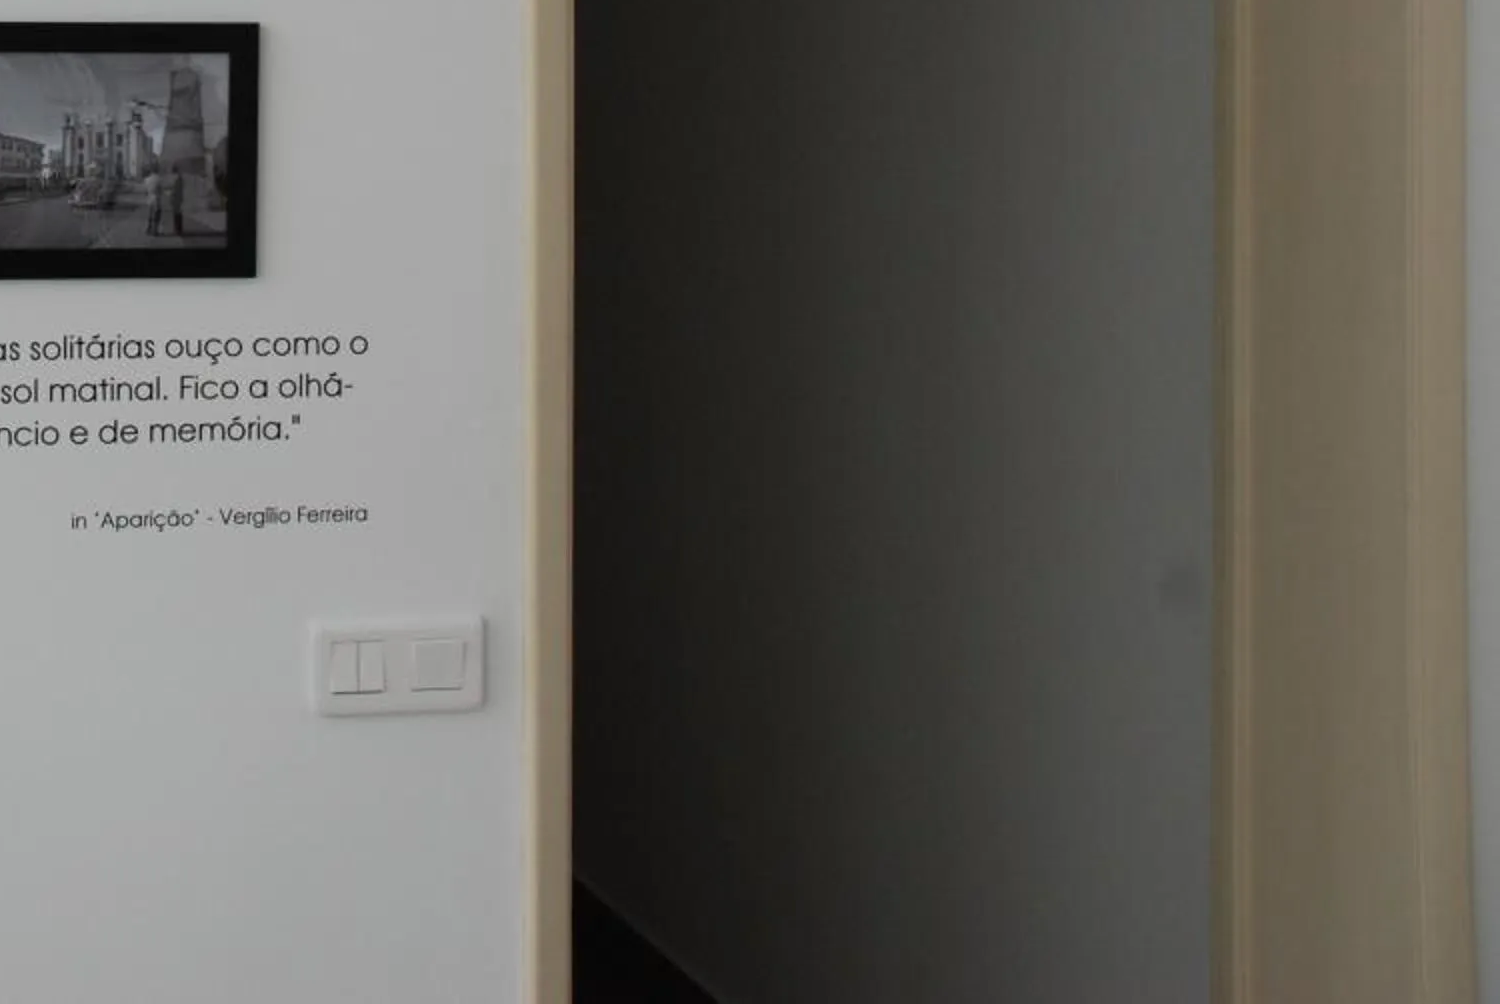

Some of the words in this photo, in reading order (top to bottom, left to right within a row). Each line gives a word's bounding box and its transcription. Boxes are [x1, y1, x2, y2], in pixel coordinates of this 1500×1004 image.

[29, 333, 156, 362] solitárias
[164, 336, 244, 367] ouço
[251, 335, 341, 358] como
[348, 334, 369, 356] o
[0, 377, 39, 405] sol
[48, 375, 169, 404] matinal.
[179, 374, 240, 401] Fico
[248, 379, 269, 400] a
[277, 371, 354, 400] olhá-
[68, 424, 89, 446] e
[97, 419, 139, 445] de
[148, 413, 301, 444] memória."
[71, 512, 88, 530] in
[296, 505, 369, 524] Ferreira
